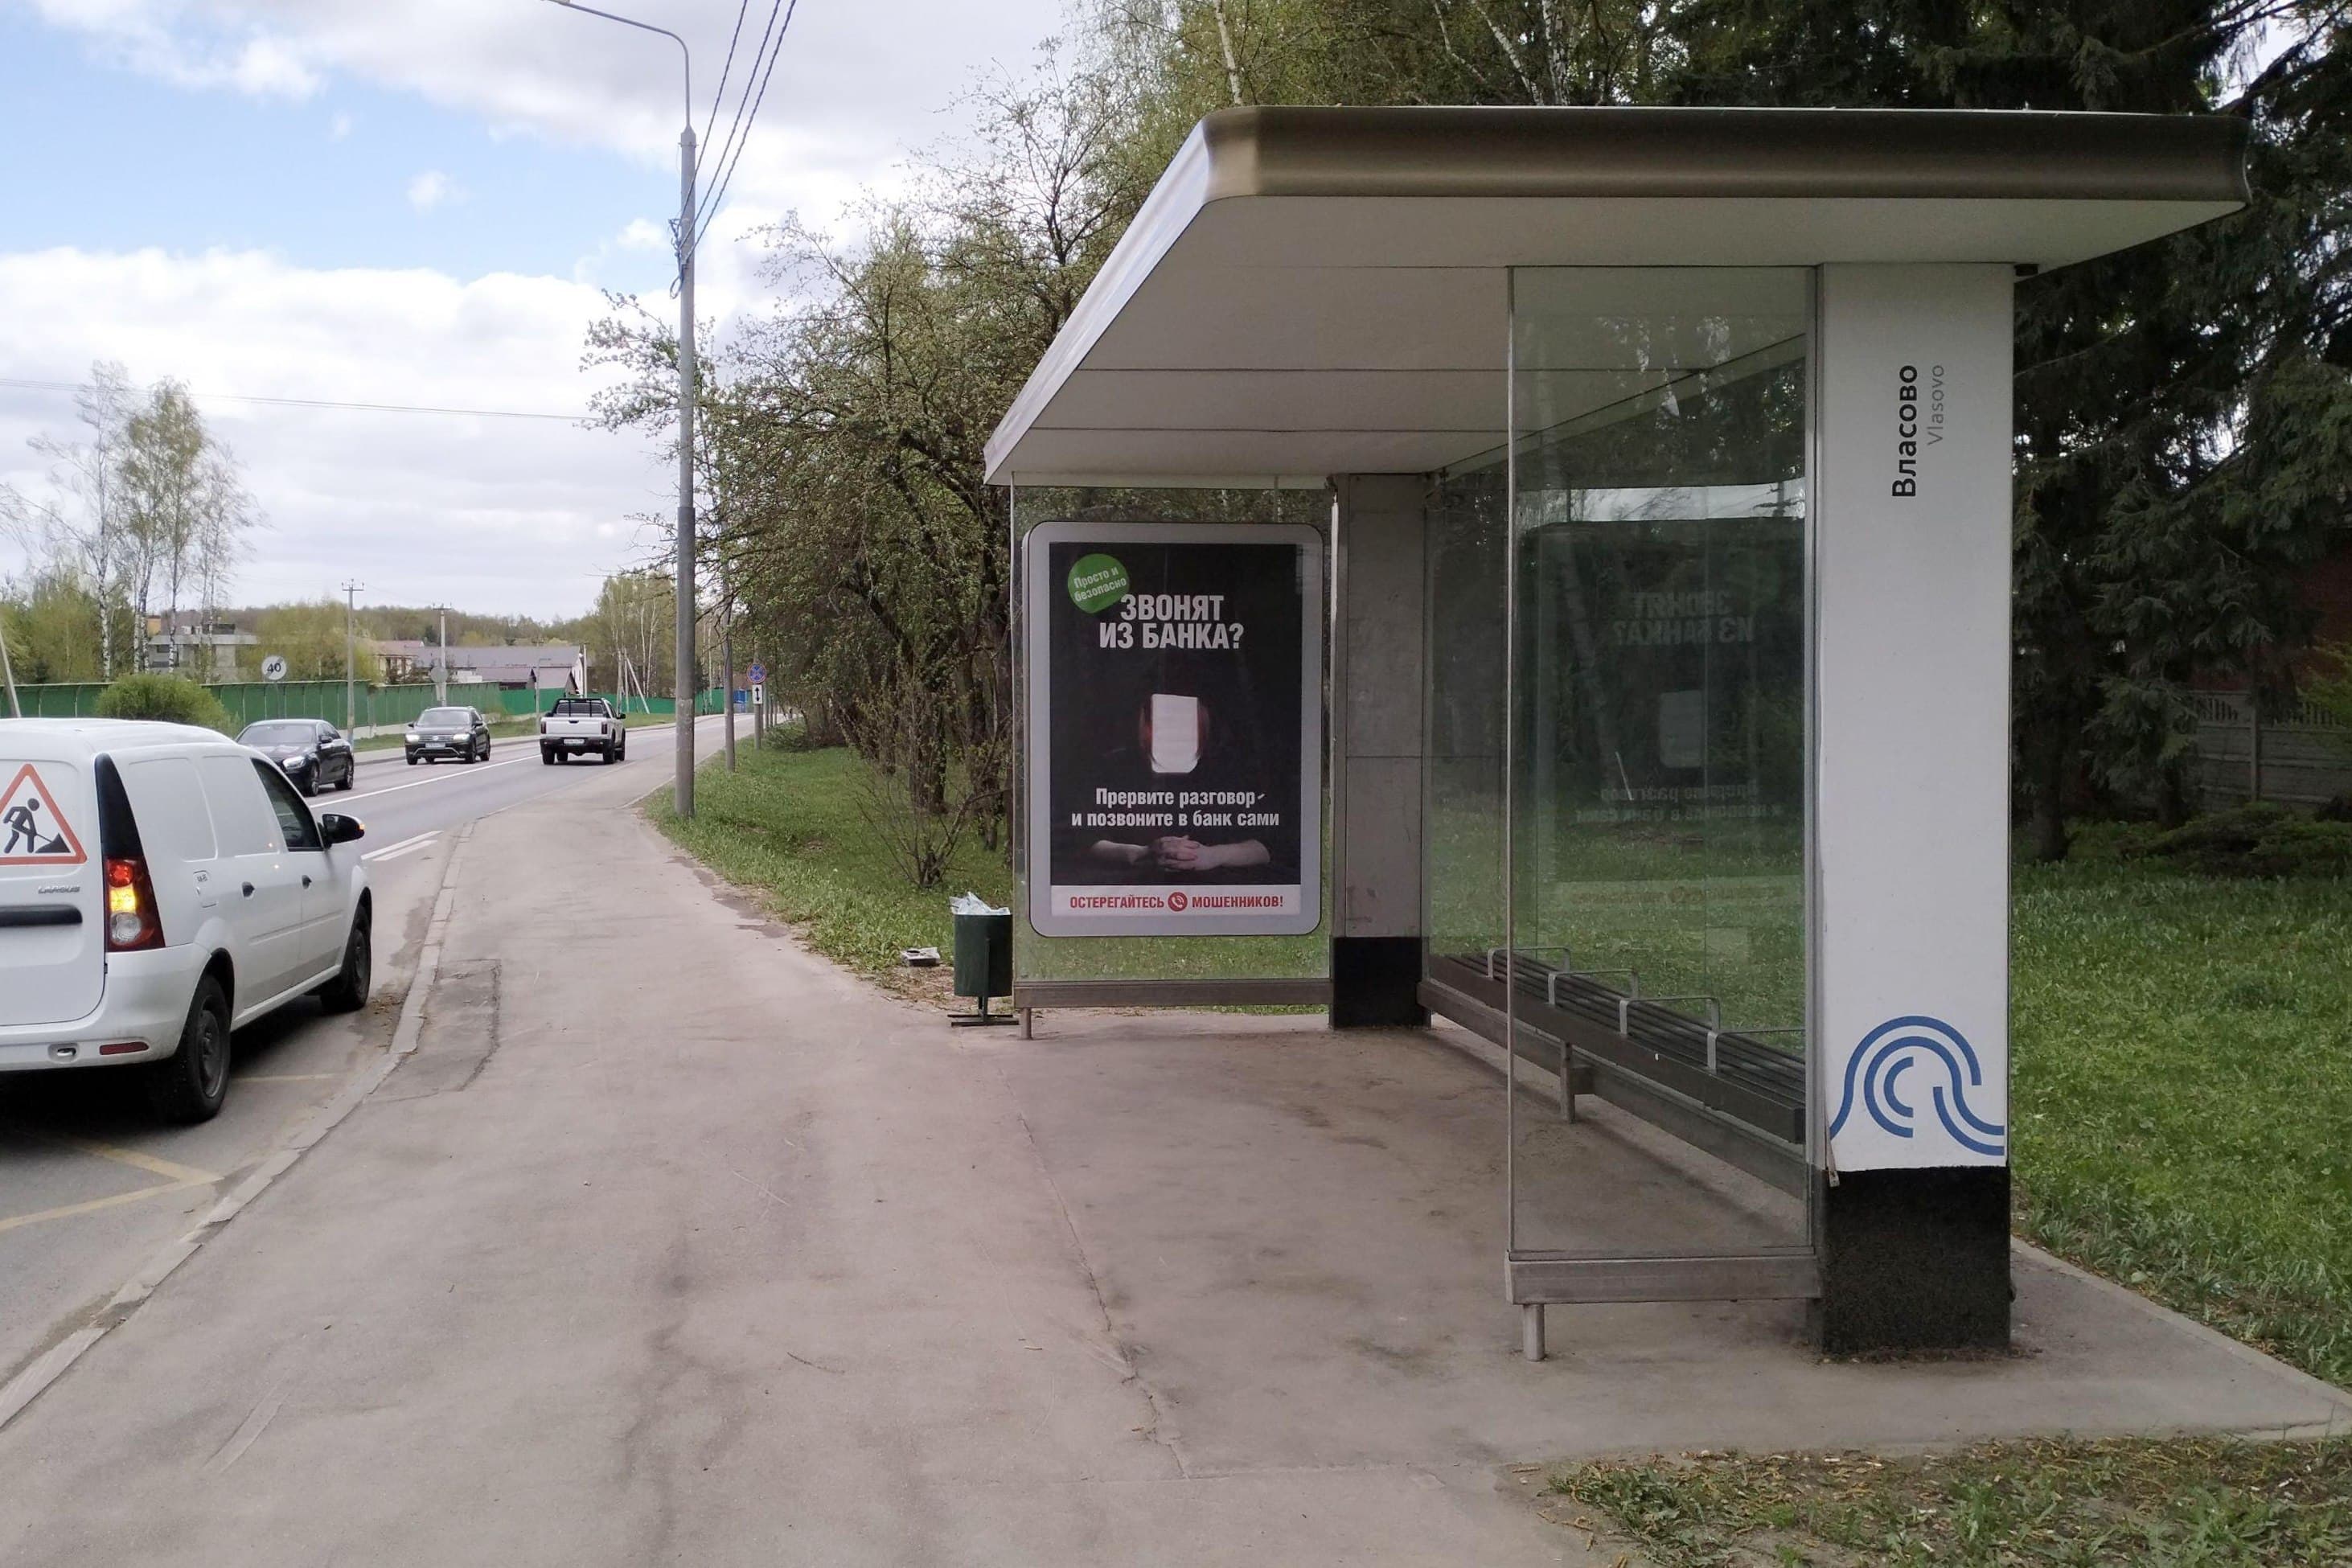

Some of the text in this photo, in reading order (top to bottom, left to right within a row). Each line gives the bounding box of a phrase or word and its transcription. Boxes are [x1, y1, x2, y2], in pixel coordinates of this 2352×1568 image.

[1927, 365, 1945, 445] Vlasovo
[1892, 365, 1918, 497] Власово
[1073, 567, 1119, 589] Просто и
[1074, 577, 1127, 602] безопасно
[1120, 594, 1224, 621] ЗВОНЯТ
[1099, 622, 1244, 649] ИЗ БАНКА?
[267, 663, 281, 674] 40
[1096, 788, 1255, 808] Прервите разговор
[1071, 810, 1279, 827] и позвоните в банк сами
[1069, 894, 1284, 909] ОСТЕРЕГАЙТЕСЬ МОШЕННИКОВ!
